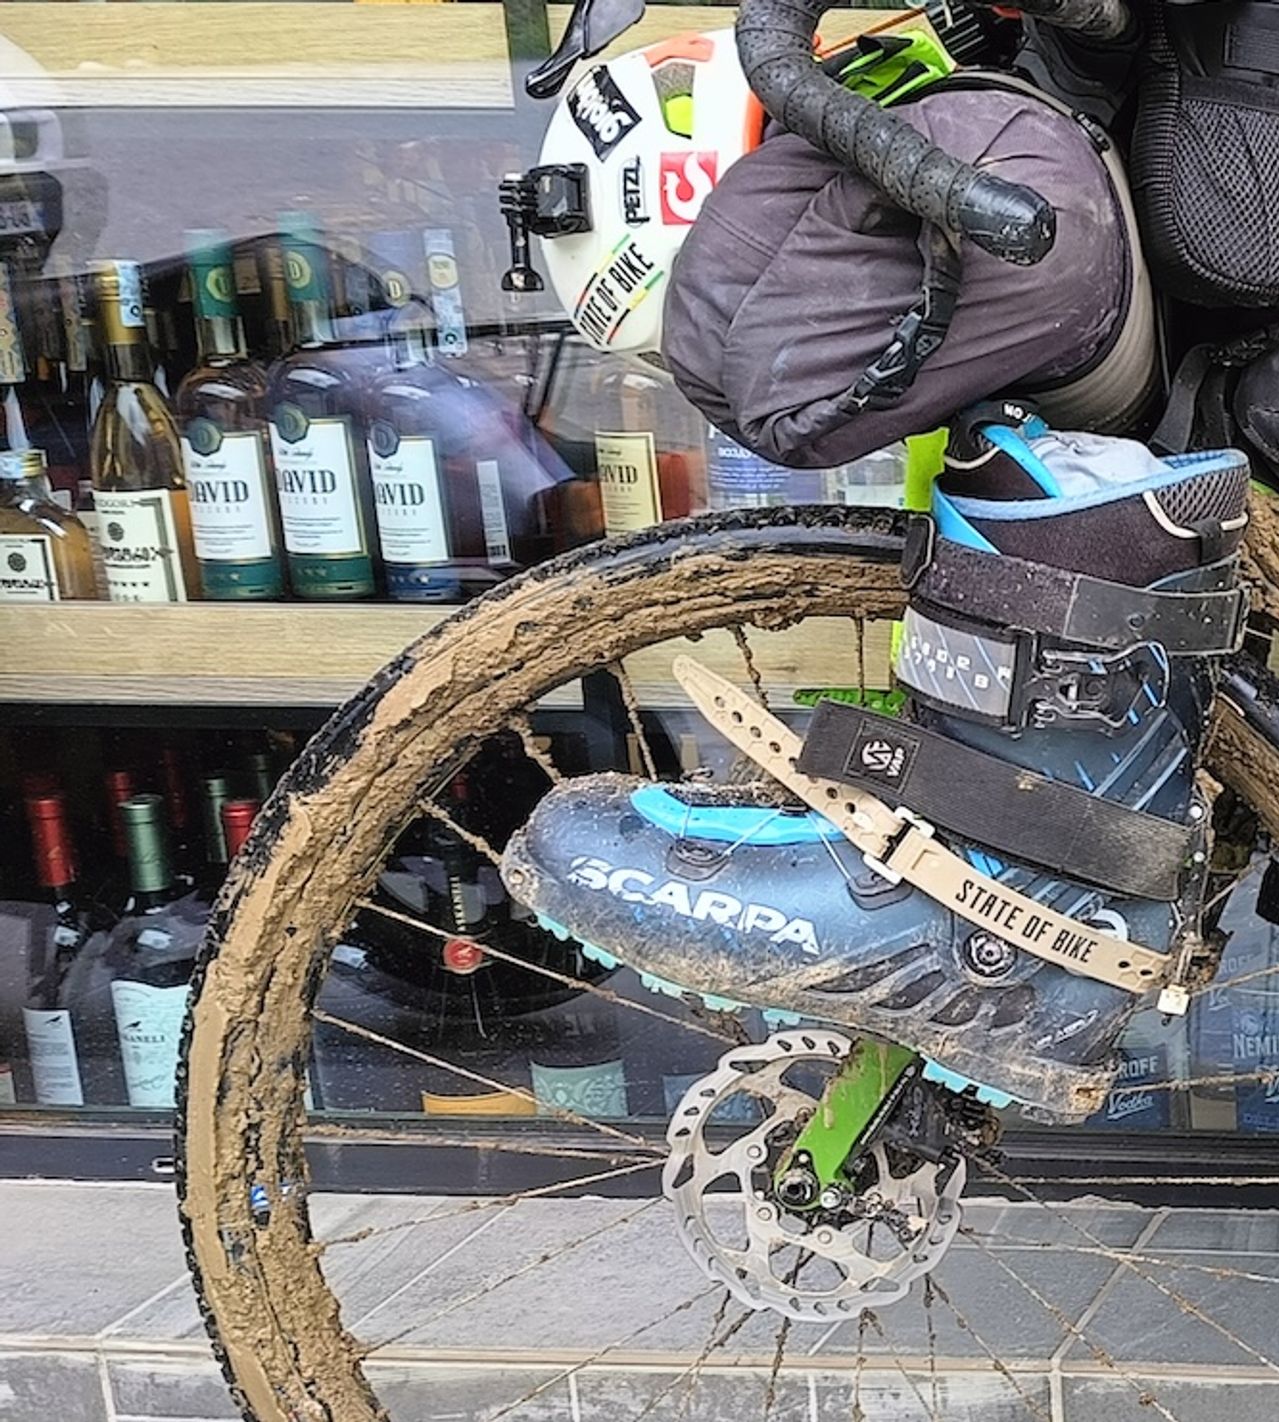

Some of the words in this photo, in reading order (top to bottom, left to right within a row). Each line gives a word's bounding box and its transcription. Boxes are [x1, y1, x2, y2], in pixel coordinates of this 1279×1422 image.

[624, 156, 650, 225] PETZL
[608, 242, 654, 293] BIKE
[595, 277, 622, 312] OF
[579, 295, 612, 346] STATE
[886, 747, 905, 777] VAP
[567, 855, 820, 956] SCARPA
[955, 878, 1024, 931] STATE
[1021, 914, 1054, 943] OF
[1051, 928, 1099, 964] BIKE
[1108, 1091, 1154, 1114] Vodka
